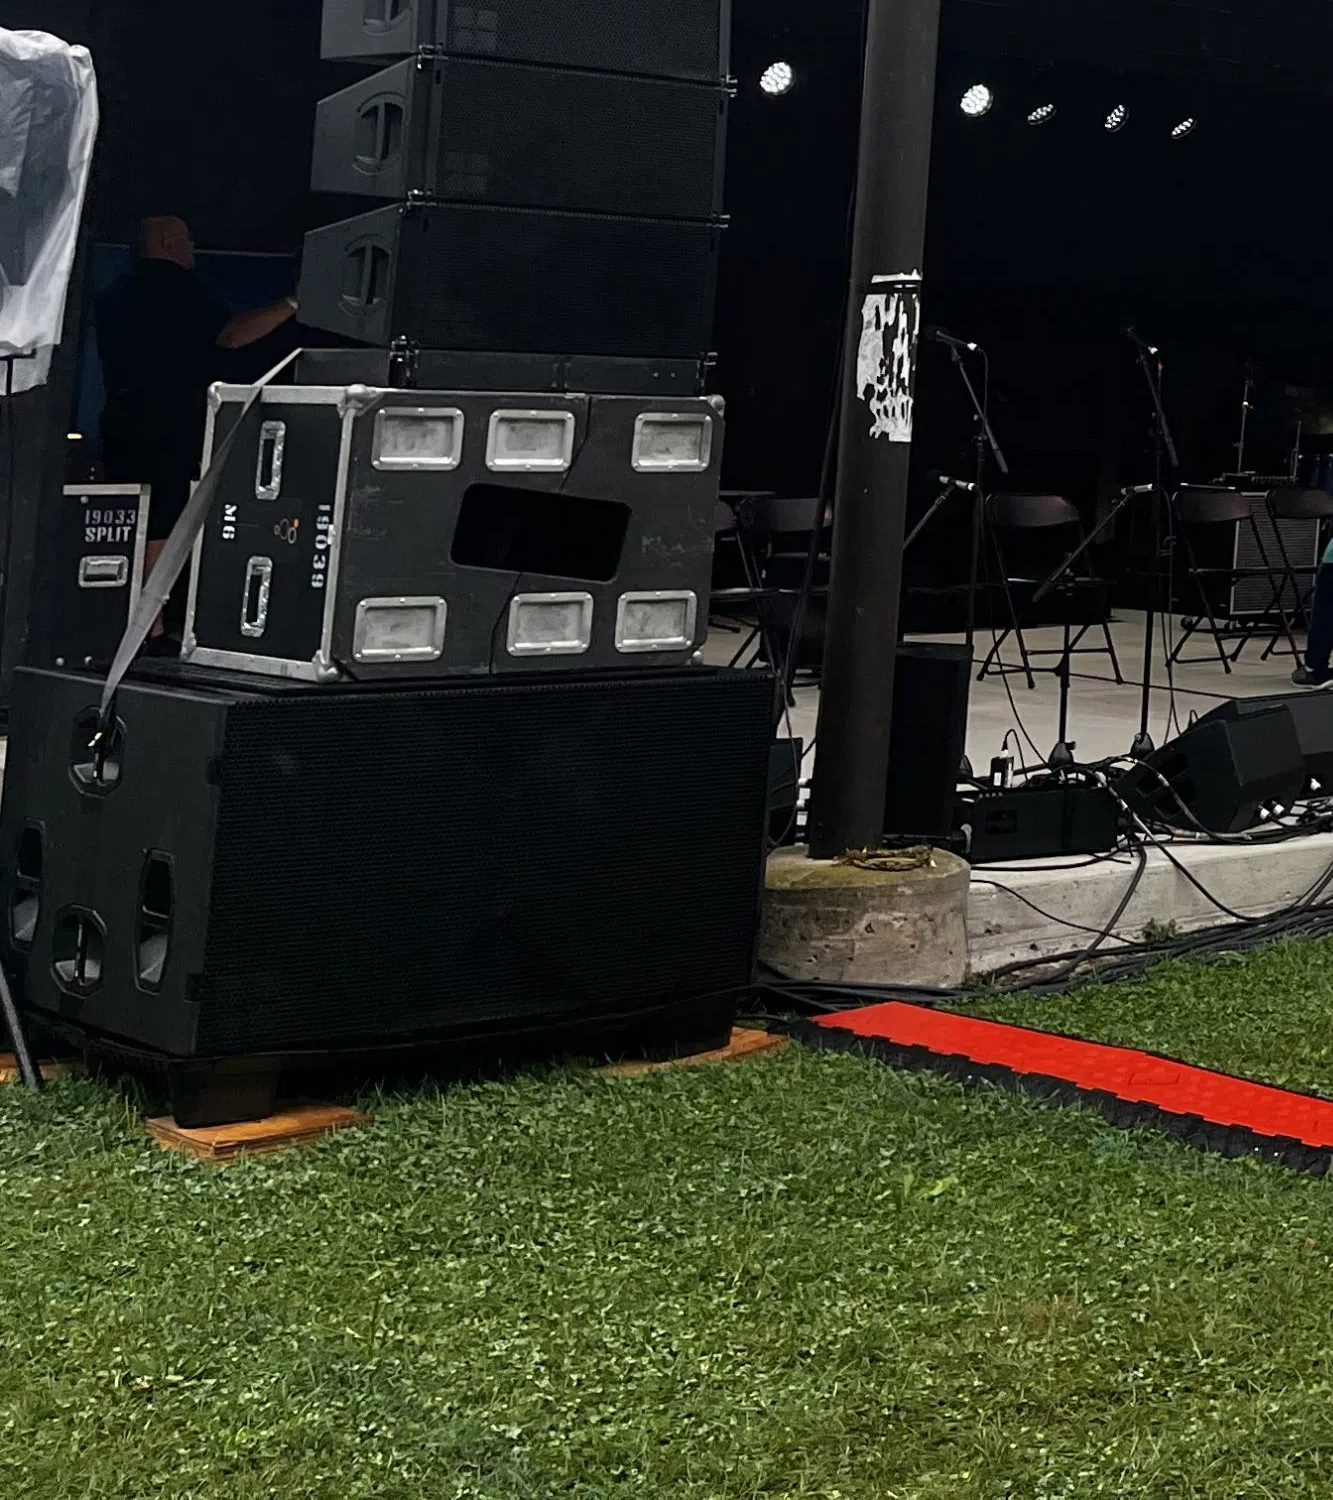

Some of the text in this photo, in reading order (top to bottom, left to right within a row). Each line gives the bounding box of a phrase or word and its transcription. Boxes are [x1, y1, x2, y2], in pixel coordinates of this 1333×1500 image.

[85, 509, 136, 525] 19033
[84, 526, 132, 542] SPLIT
[311, 504, 331, 588] 19039
